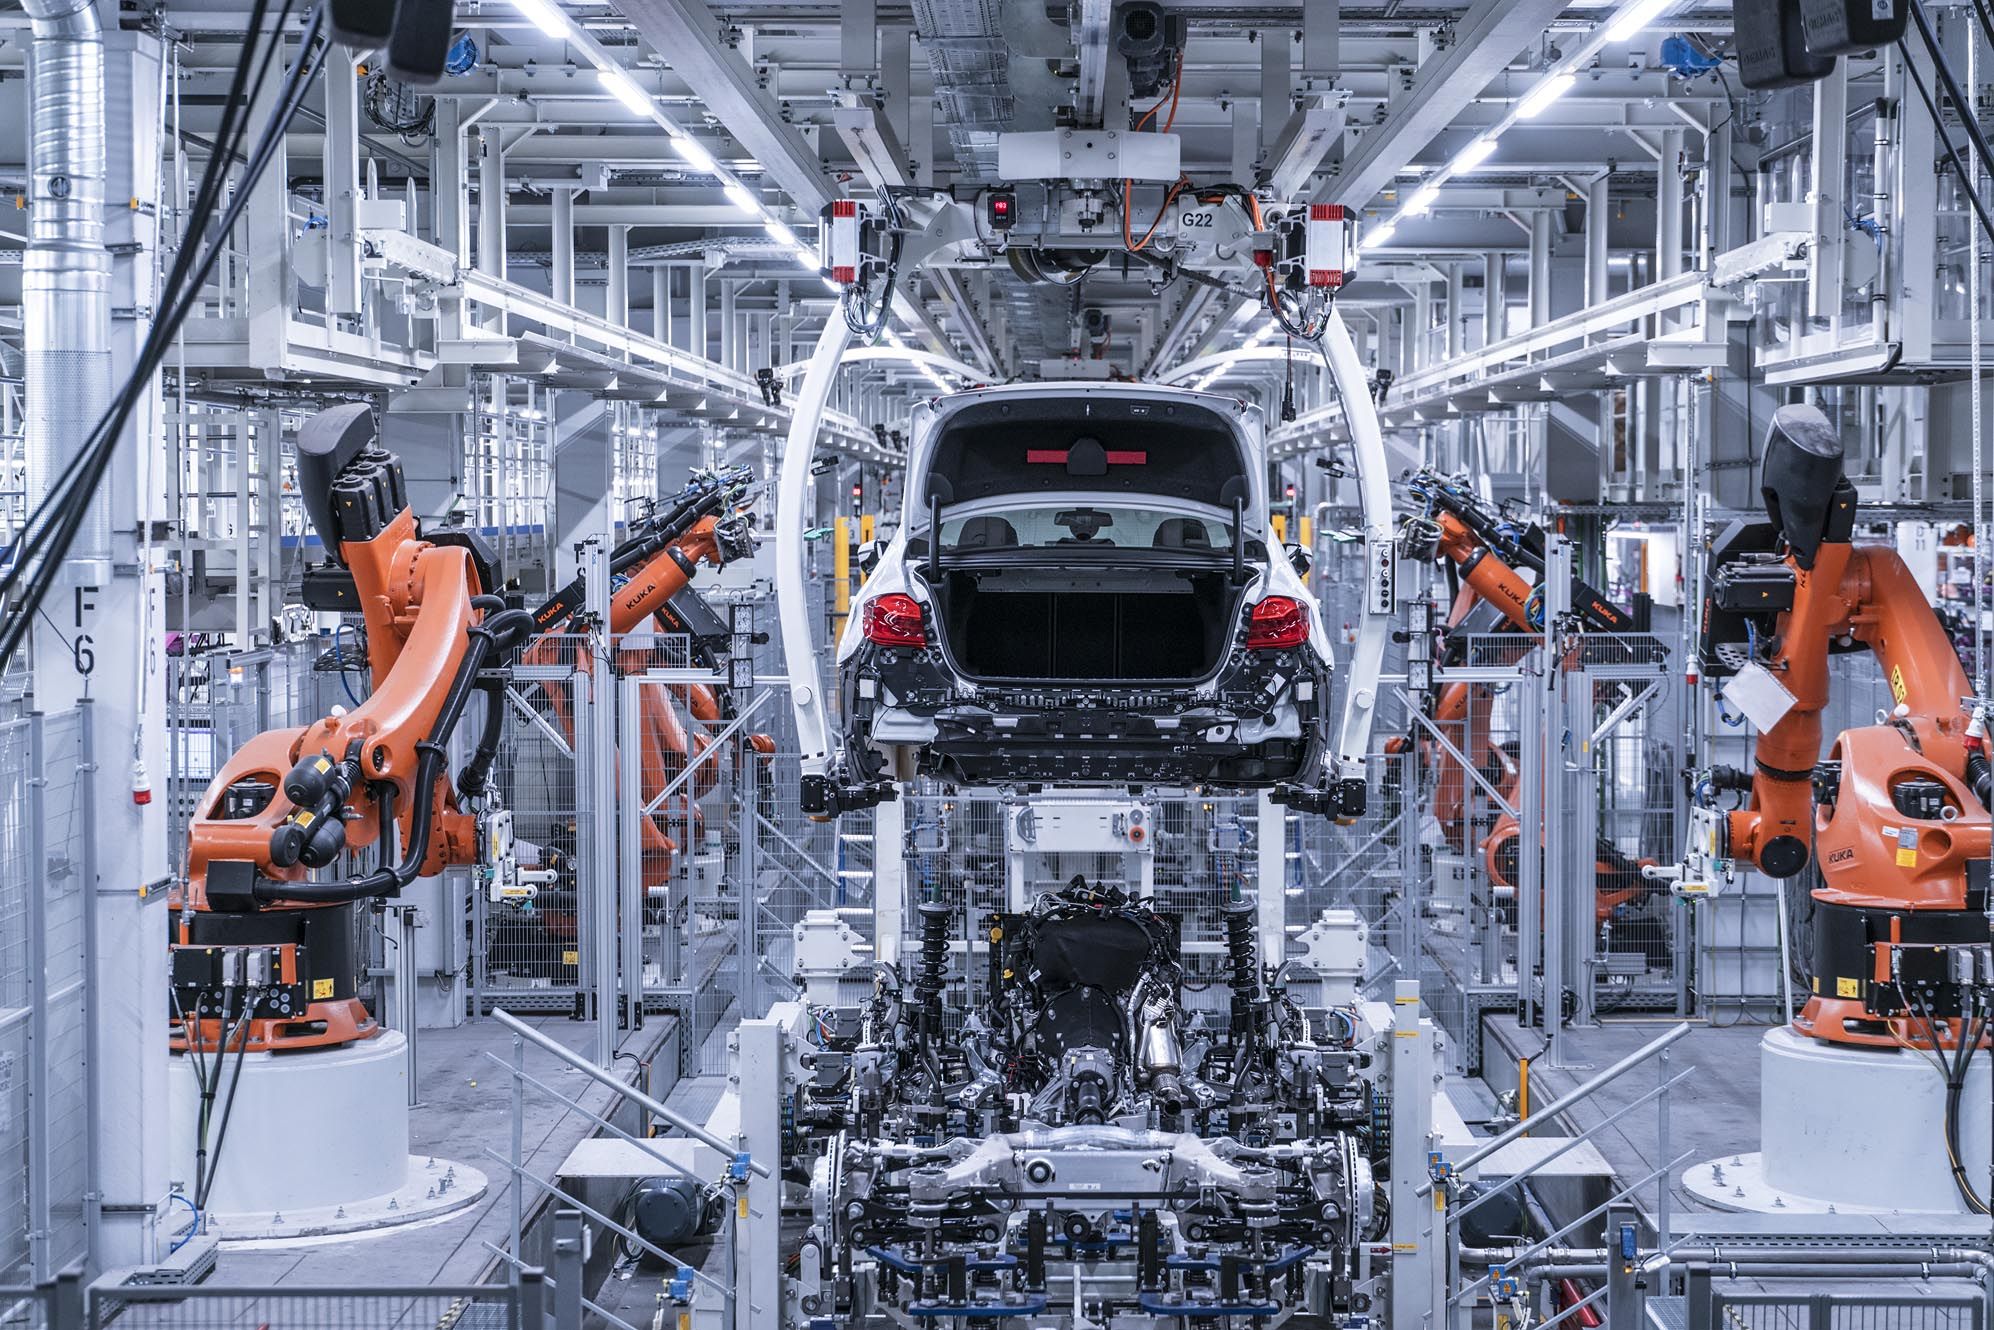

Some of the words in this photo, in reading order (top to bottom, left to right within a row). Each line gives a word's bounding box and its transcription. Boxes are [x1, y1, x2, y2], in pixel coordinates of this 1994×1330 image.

[1182, 212, 1213, 228] G22
[75, 586, 99, 628] F
[626, 584, 656, 610] KUKA
[537, 602, 564, 624] KUKA
[661, 607, 680, 629] KUKA
[1592, 600, 1618, 625] KUKA
[75, 634, 95, 675] 6
[1829, 849, 1854, 864] KUKA
